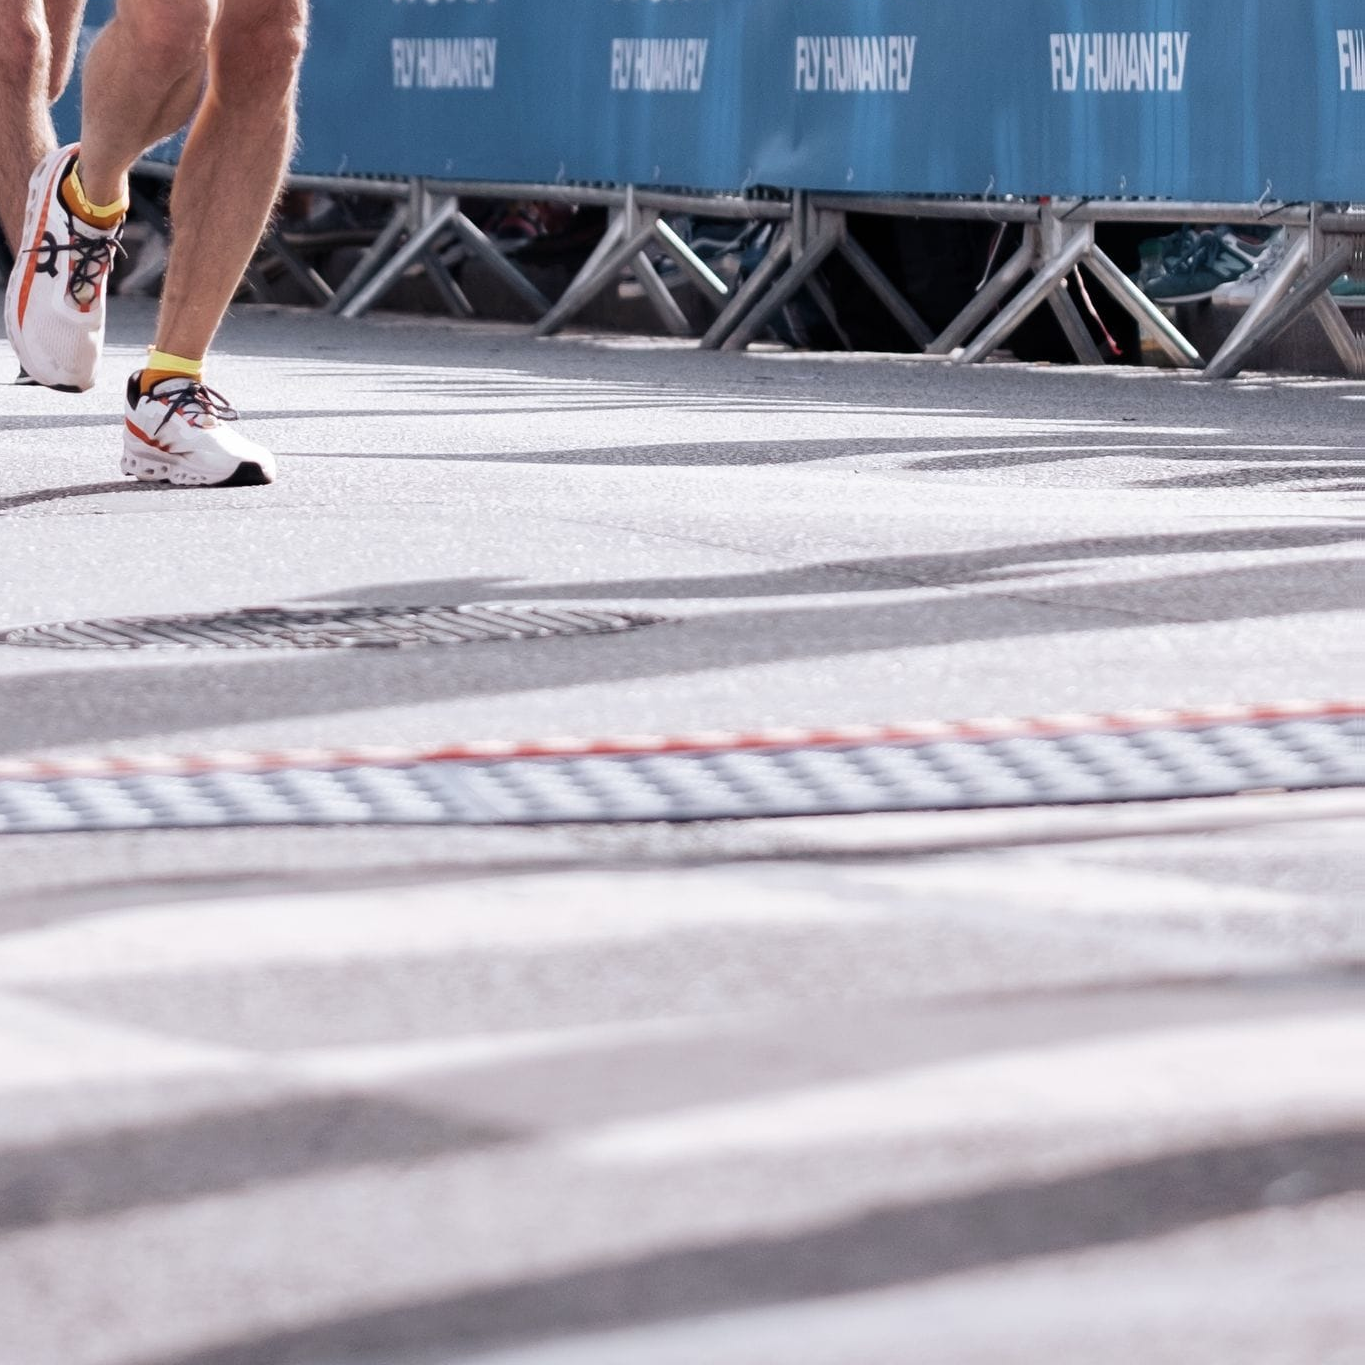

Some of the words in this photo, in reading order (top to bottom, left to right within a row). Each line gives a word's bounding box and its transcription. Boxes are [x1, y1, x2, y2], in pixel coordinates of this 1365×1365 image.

[391, 37, 415, 88] FLY
[416, 37, 473, 89] HUMAN
[473, 37, 498, 88] FLY
[610, 37, 634, 91] FLY
[634, 37, 686, 92] HUMAN
[683, 37, 709, 92] FLY
[795, 35, 821, 92] FLY
[822, 35, 886, 93] HUMAN
[887, 35, 917, 92] FLY
[1050, 32, 1082, 92] FLY
[1083, 32, 1155, 93] HUMAN
[1157, 31, 1189, 92] FLY
